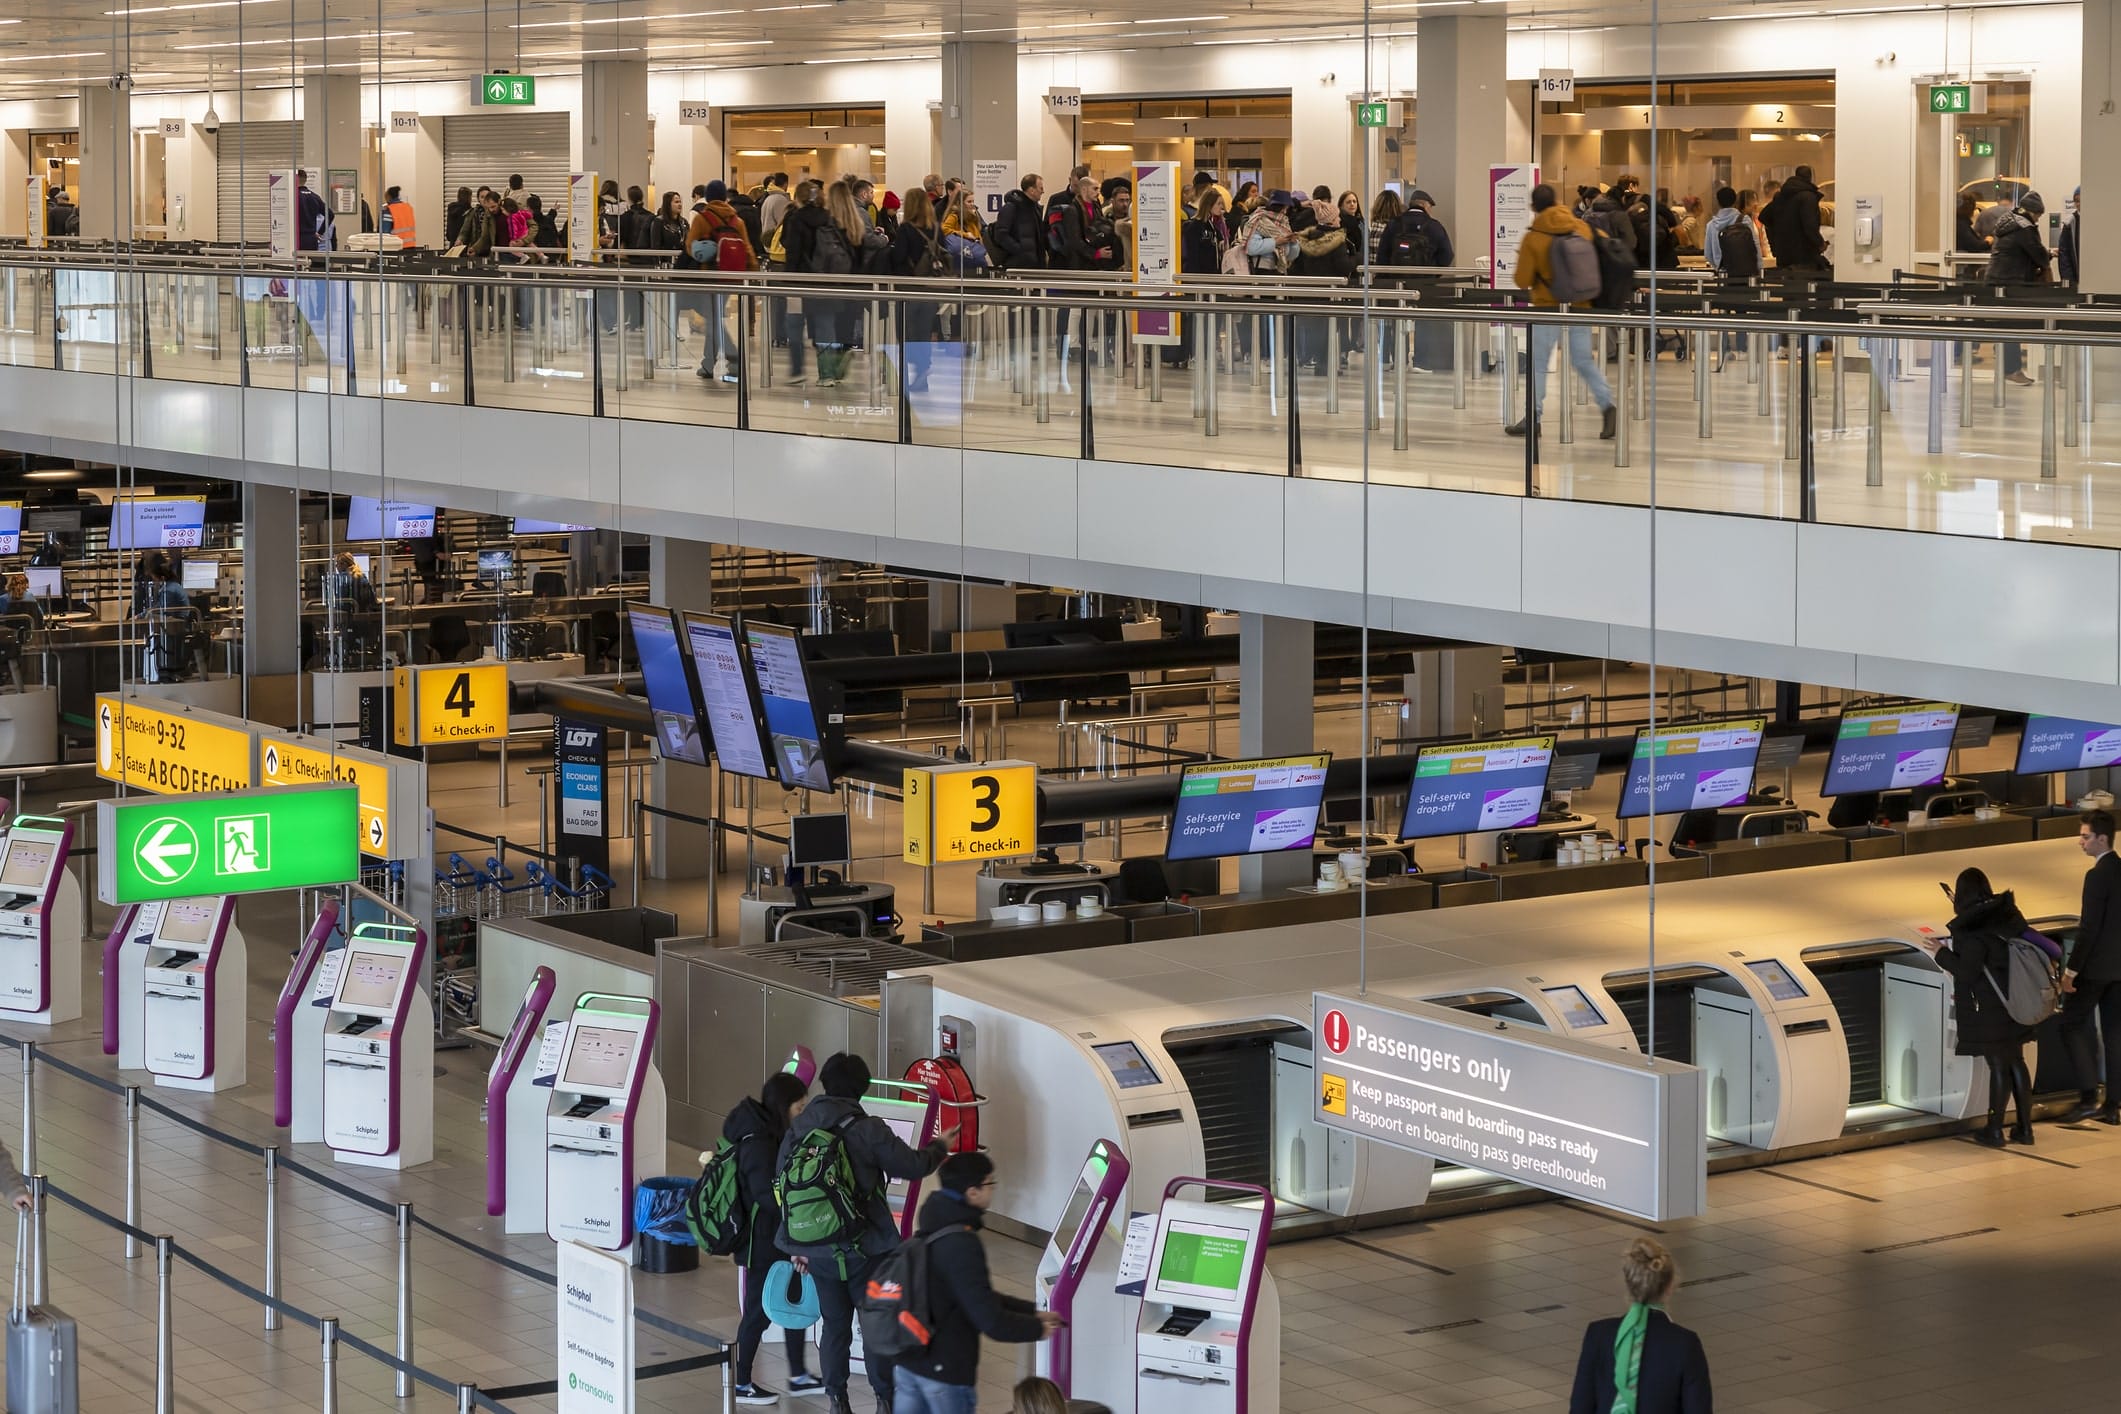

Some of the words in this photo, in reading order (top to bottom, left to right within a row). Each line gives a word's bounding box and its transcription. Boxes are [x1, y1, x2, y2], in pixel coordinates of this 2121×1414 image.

[1542, 79, 1571, 91] 16-17
[1052, 95, 1079, 107] 14-15
[682, 108, 707, 118] 12-13
[1643, 112, 1649, 124] 1
[1776, 111, 1784, 122] 2
[166, 124, 180, 132] 8-9
[394, 118, 416, 127] 10-11
[1183, 122, 1188, 133] 1
[824, 131, 829, 141] 1
[400, 675, 404, 688] 4
[444, 673, 475, 718] 4
[362, 707, 370, 733] GOLD
[1753, 721, 1760, 731] 3
[126, 716, 156, 737] Check-in
[157, 719, 186, 750] 9-32
[450, 724, 495, 736] Check-in
[565, 730, 598, 748] LOT
[1543, 738, 1550, 748] 2
[2032, 731, 2075, 743] Self-service
[1430, 745, 1462, 755] Self-service
[1464, 743, 1489, 752] baggage
[1489, 741, 1514, 750] drop-off
[2029, 742, 2062, 754] drop-off
[568, 754, 588, 762] CHECK
[1318, 757, 1324, 767] 1
[1530, 754, 1547, 763] SWISS
[1840, 751, 1886, 764] Self-service
[295, 759, 331, 782] Check-in
[335, 764, 357, 785] 1-8
[1196, 763, 1231, 774] Self-service
[1232, 761, 1258, 771] baggage
[1260, 759, 1285, 769] drop-off
[1837, 762, 1872, 775] drop-off
[126, 756, 147, 774] Gates
[148, 757, 248, 792] ABCDEFGH
[566, 772, 598, 782] ECONOMY
[1637, 771, 1685, 784] Sel-service
[577, 783, 598, 792] CLASS
[911, 779, 917, 795] 3
[971, 775, 1000, 832] 3
[1418, 791, 1471, 804] Self-service
[583, 809, 598, 817] FAST
[1416, 803, 1456, 816] drop-off
[566, 818, 579, 826] BAG
[580, 819, 598, 827] DROP
[1185, 811, 1241, 824] Self-service
[1183, 823, 1224, 836] drop-off
[969, 838, 1020, 853] Check-in
[174, 1052, 195, 1060] Schiphol
[1356, 1025, 1461, 1073] Passengers
[1467, 1058, 1511, 1092] only
[1352, 1080, 1382, 1104] Keep
[1385, 1091, 1437, 1117] passport
[1440, 1105, 1464, 1124] and
[1467, 1110, 1525, 1144] boarding
[1528, 1130, 1557, 1149] pass
[1560, 1139, 1599, 1164] ready
[356, 1126, 379, 1134] Schiphol
[1352, 1105, 1403, 1133] Paspoort
[1406, 1123, 1421, 1138] en
[1424, 1125, 1479, 1158] boarding
[1482, 1144, 1509, 1163] pass
[1512, 1152, 1606, 1191] gereedhouden
[584, 1217, 610, 1227] Schiphol
[567, 1284, 592, 1303] Schiphol
[567, 1340, 594, 1359] Self-Service
[578, 1378, 614, 1404] transavia
